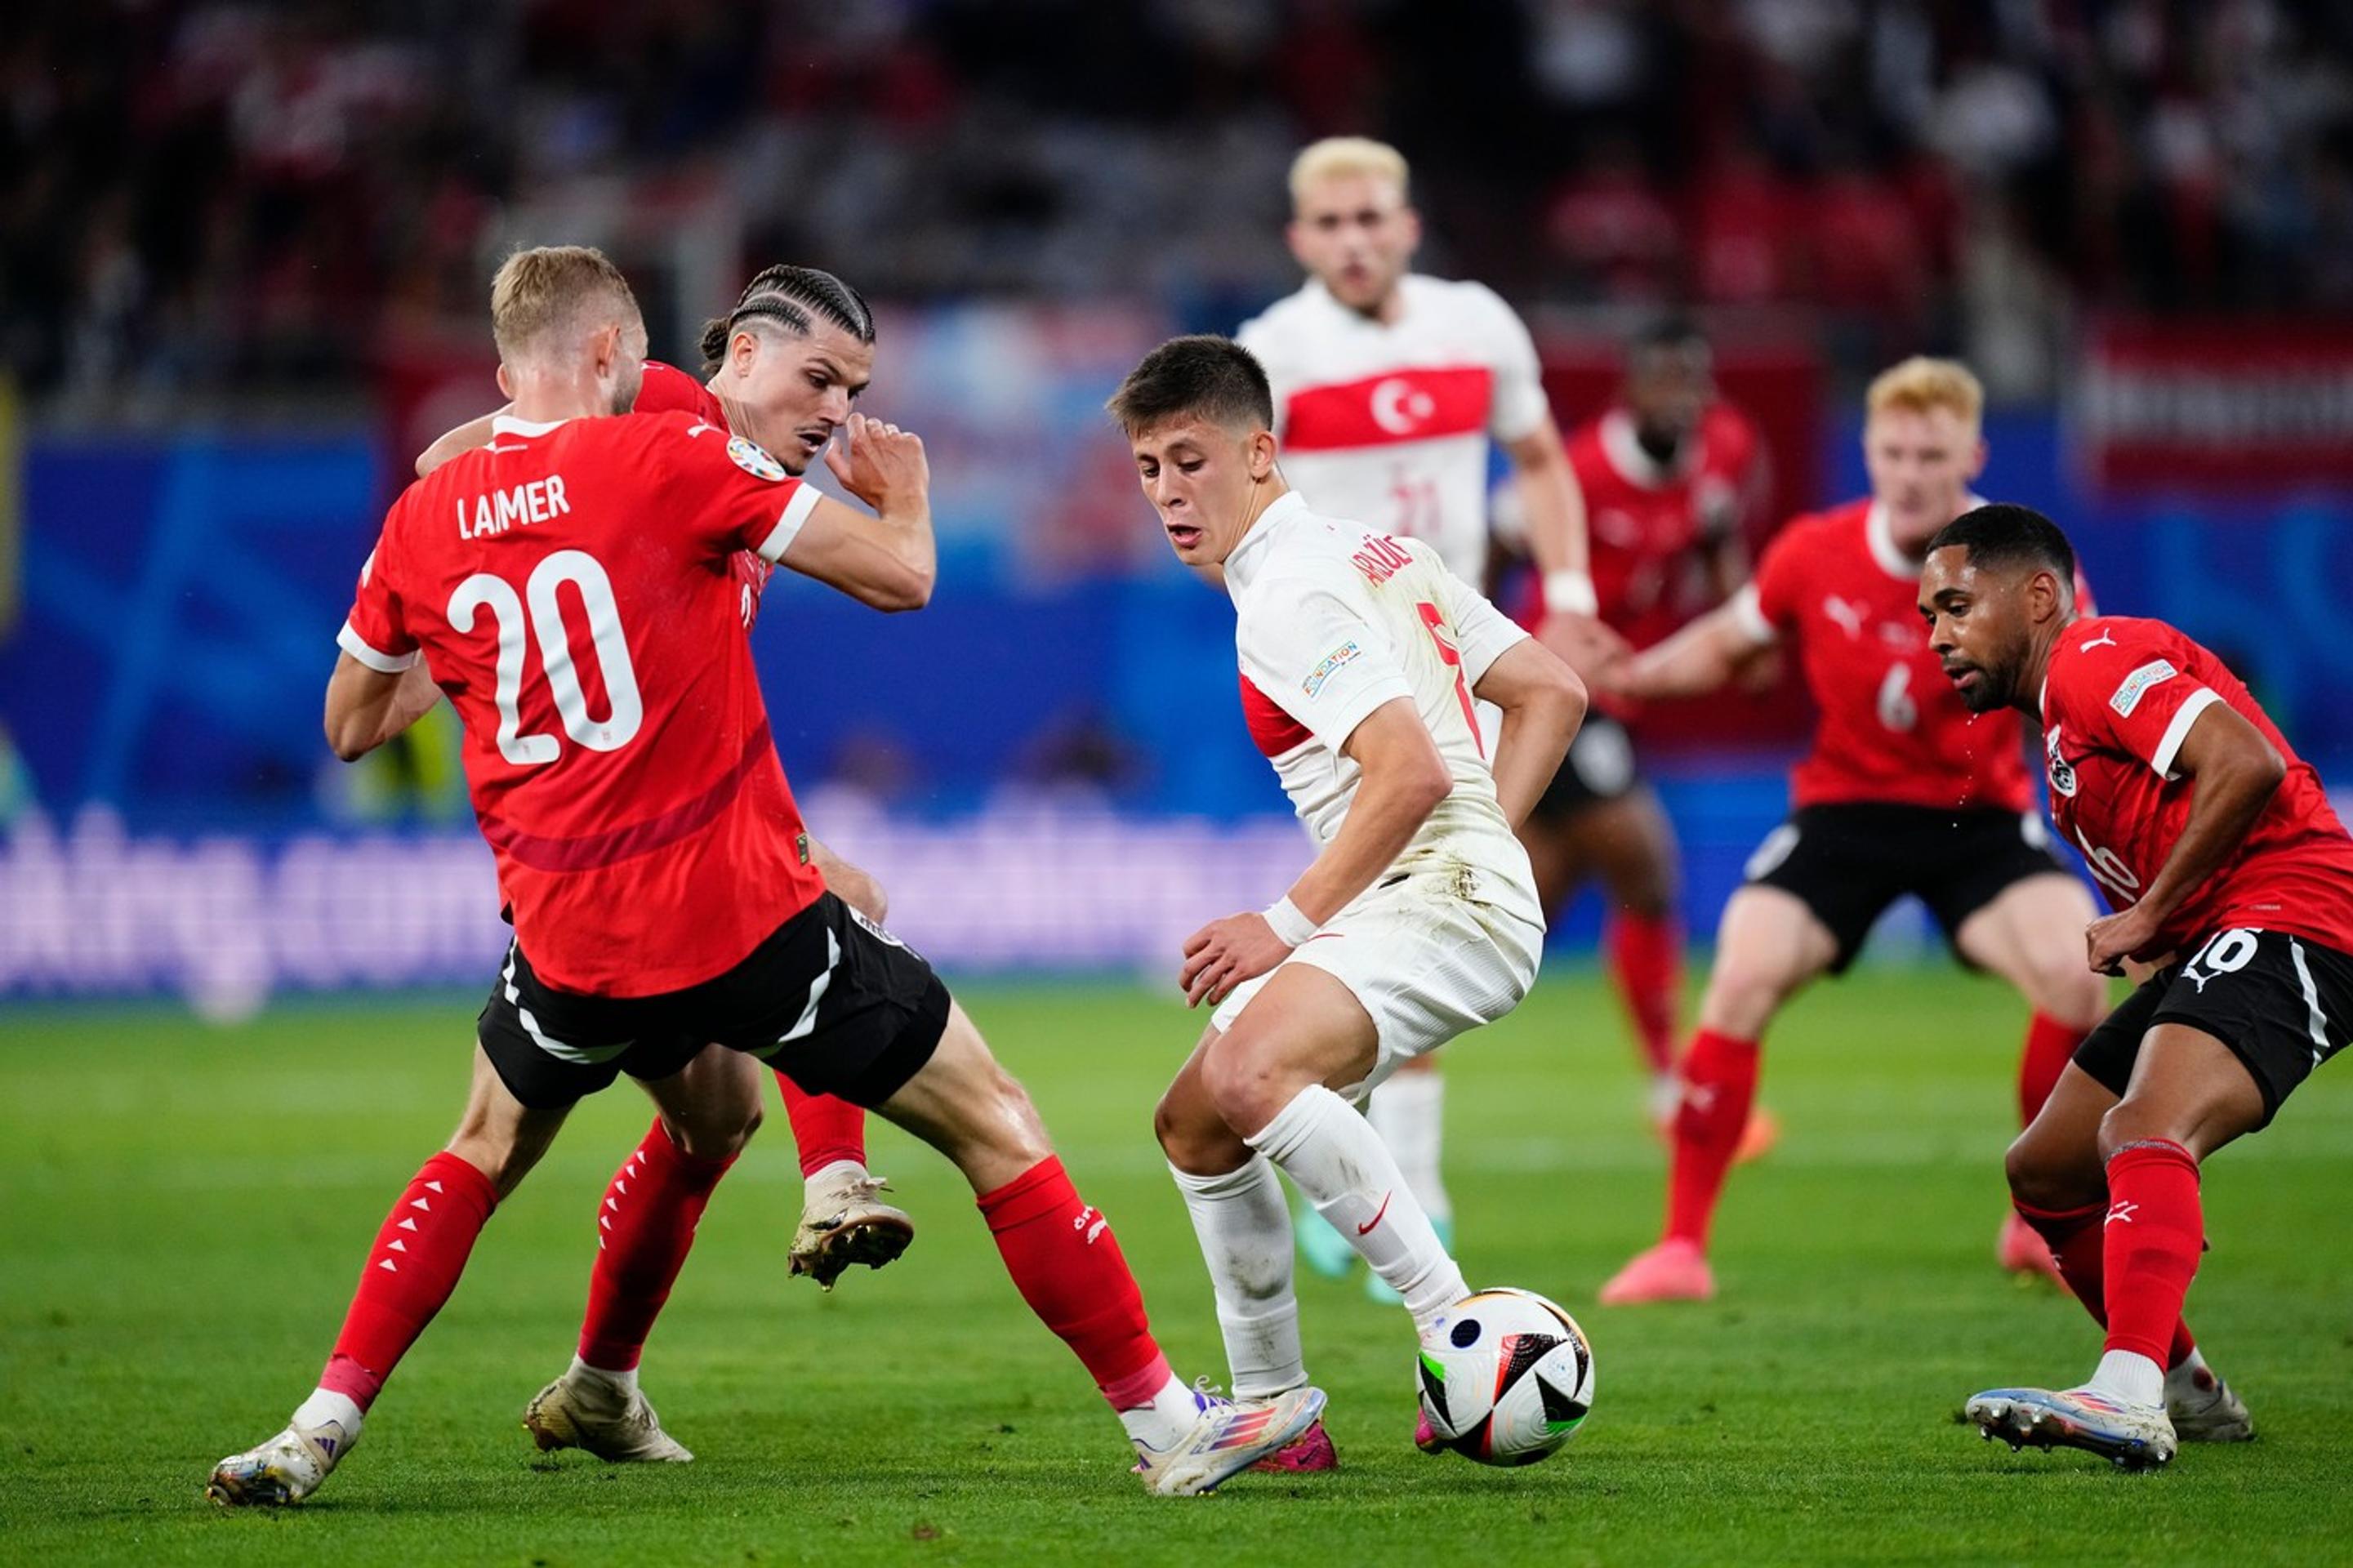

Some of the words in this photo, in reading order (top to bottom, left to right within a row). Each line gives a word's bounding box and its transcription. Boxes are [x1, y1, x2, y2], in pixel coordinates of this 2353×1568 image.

[457, 474, 570, 540] LAIMER
[446, 549, 644, 765] 20
[1877, 662, 1917, 733] 6
